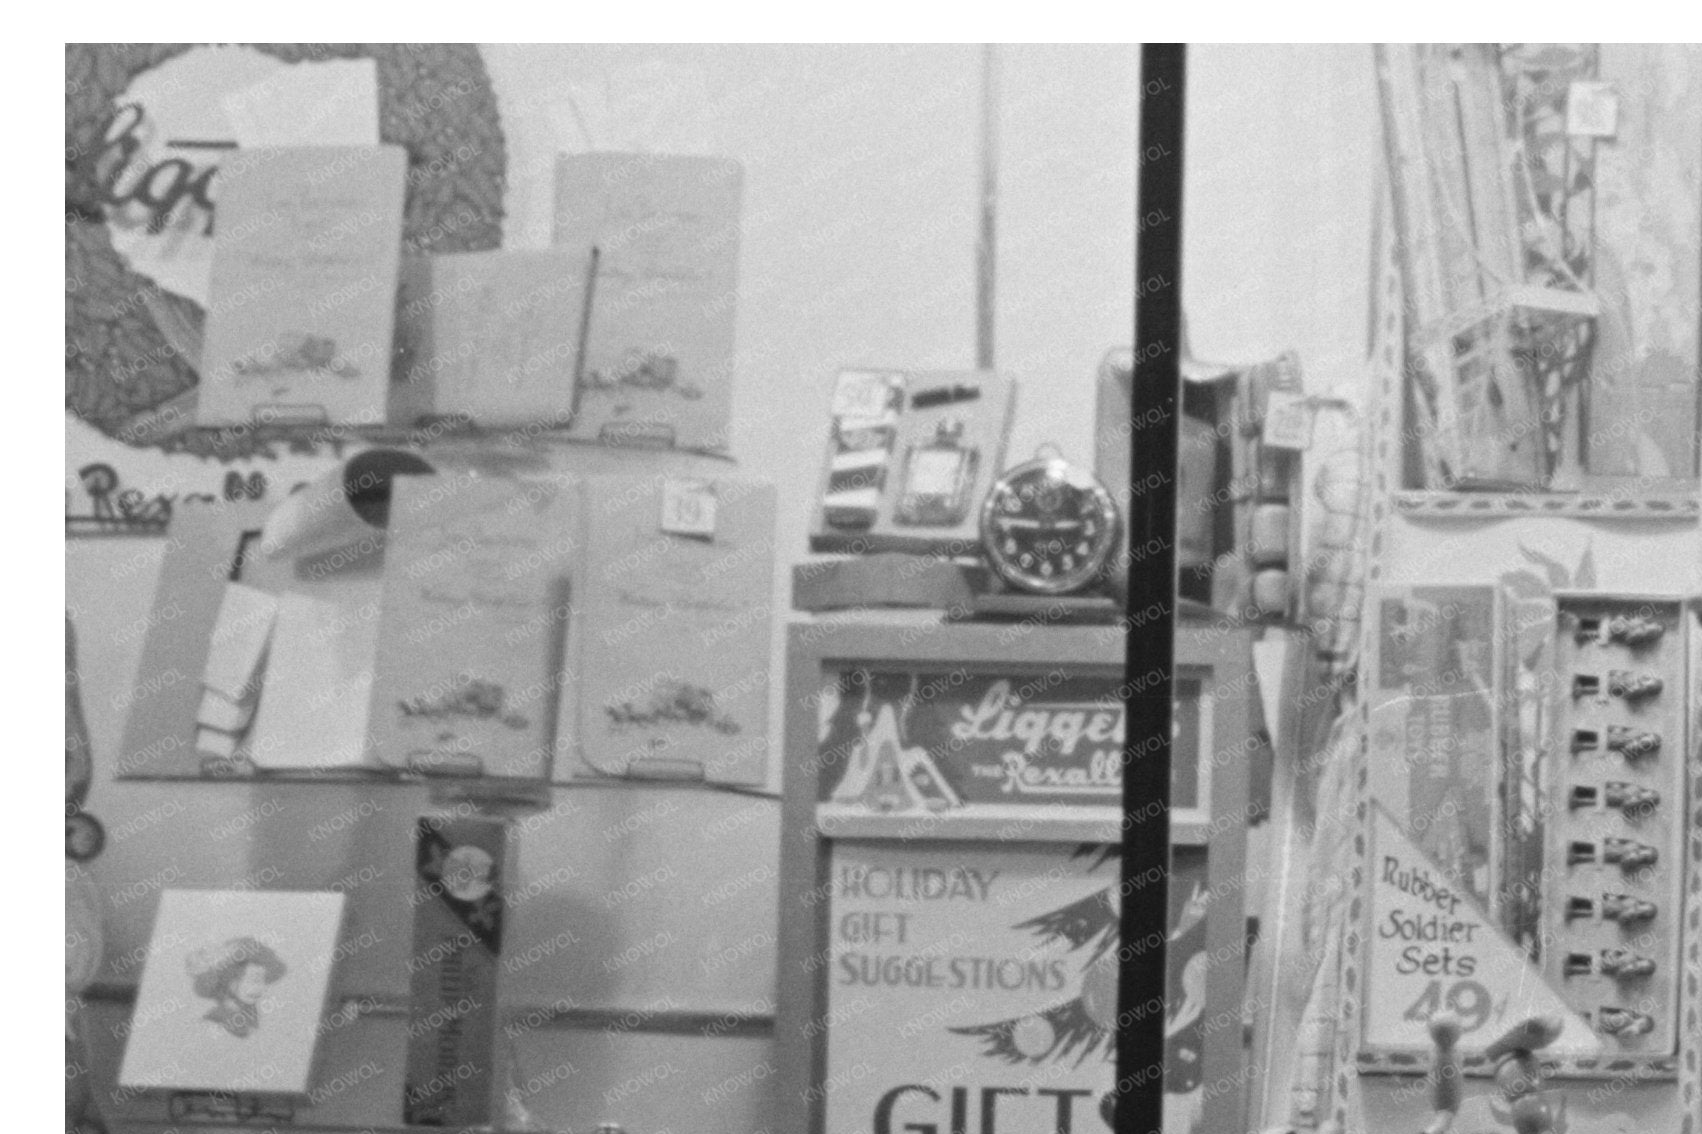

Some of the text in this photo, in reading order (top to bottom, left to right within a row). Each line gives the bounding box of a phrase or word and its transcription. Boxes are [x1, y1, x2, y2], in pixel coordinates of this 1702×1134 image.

[838, 865, 1000, 902] HOLIDAY
[1383, 855, 1462, 916] Rubber
[839, 910, 911, 945] GIFT
[1379, 910, 1480, 944] Soldier
[838, 951, 1067, 990] SUGGESTIONS
[1396, 946, 1477, 978] Sets
